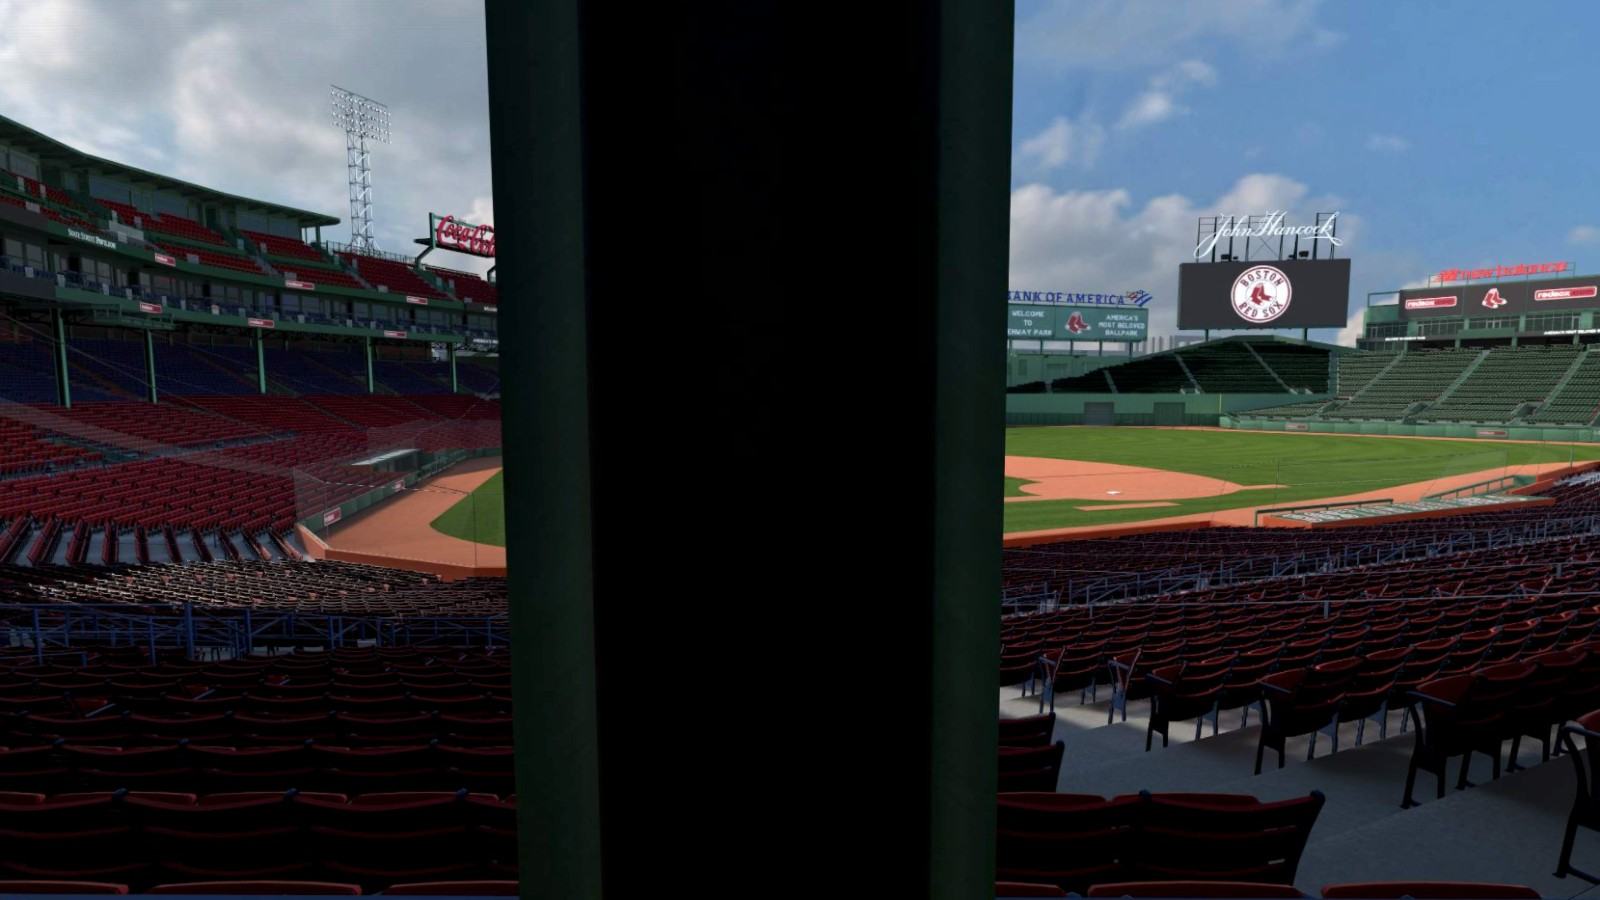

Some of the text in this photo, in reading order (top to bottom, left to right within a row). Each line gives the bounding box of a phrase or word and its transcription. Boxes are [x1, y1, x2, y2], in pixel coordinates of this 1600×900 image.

[437, 213, 495, 257] Coca-Col
[1193, 209, 1344, 259] John Hancock
[1239, 270, 1285, 288] BOSTON
[1046, 292, 1063, 303] OF
[1066, 293, 1126, 305] AMERICA
[1012, 310, 1045, 318] WELCOME
[1238, 300, 1284, 318] RED SOX
[1023, 319, 1033, 327] TO
[1105, 314, 1138, 322] AMERICA'S
[1098, 321, 1116, 329] MOST
[1007, 328, 1052, 336] ENWAY PARK
